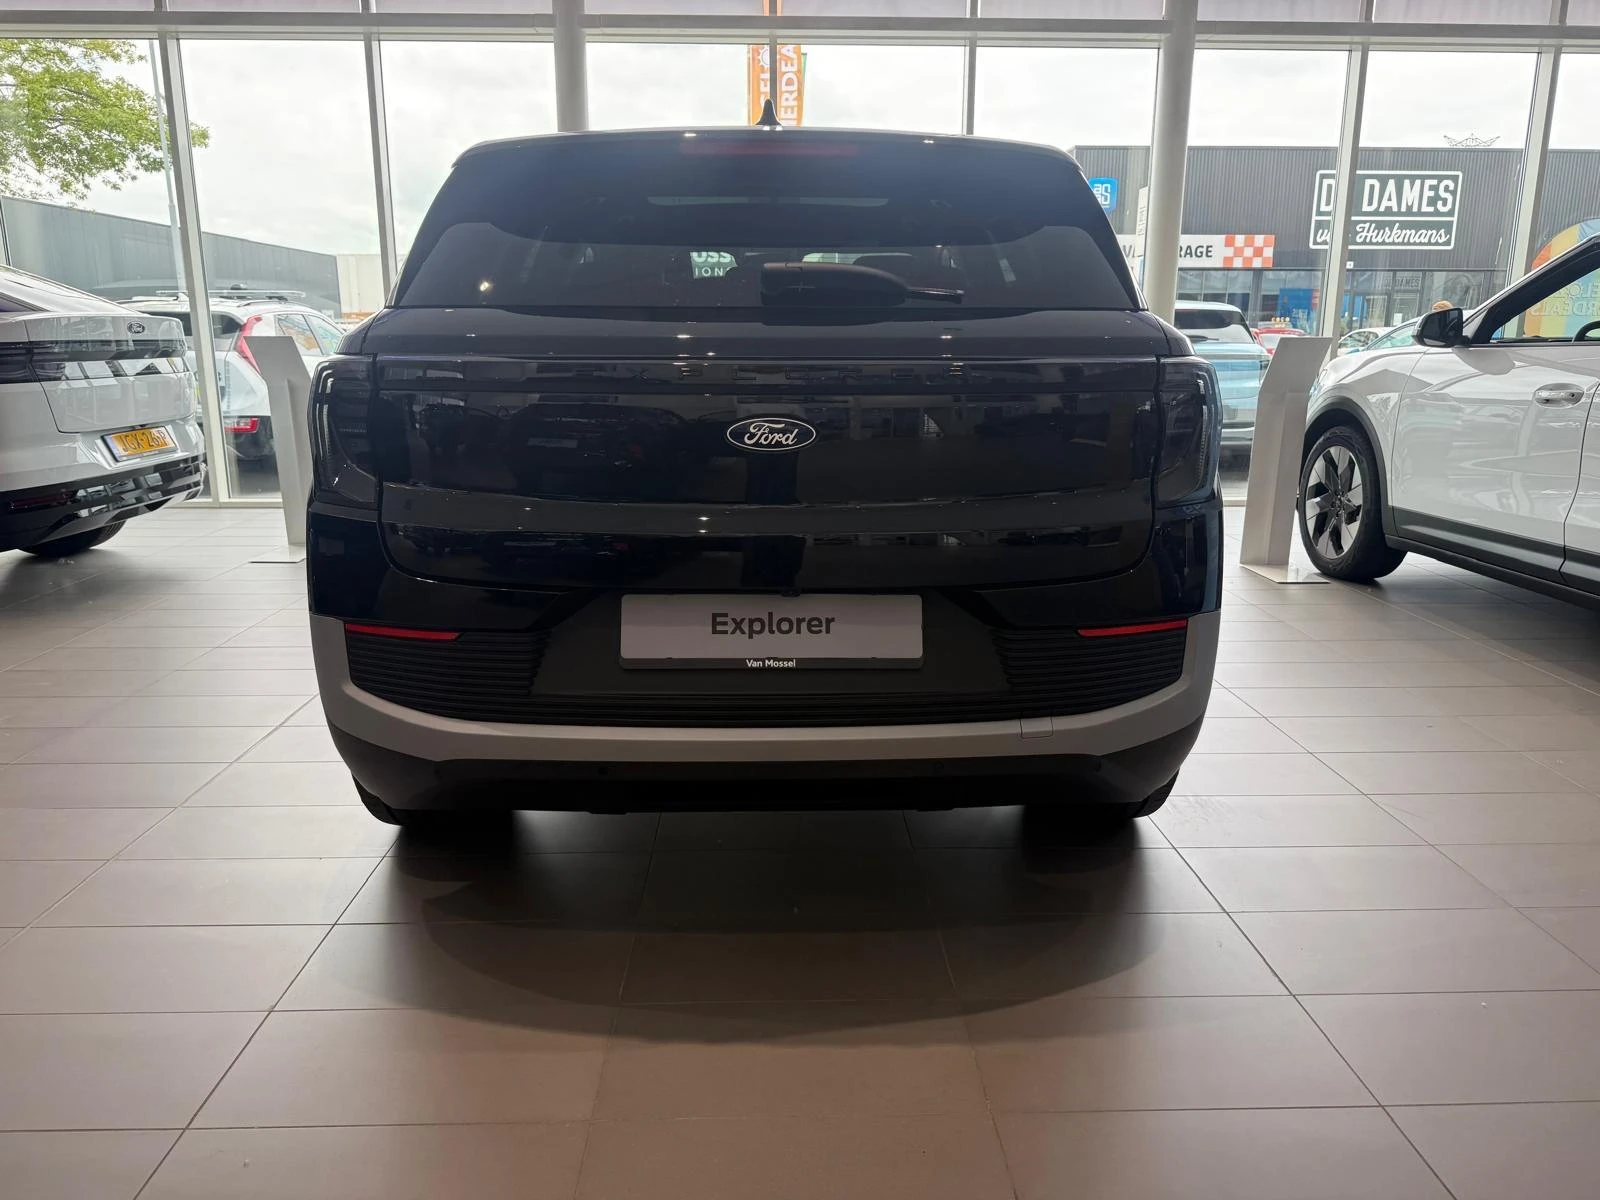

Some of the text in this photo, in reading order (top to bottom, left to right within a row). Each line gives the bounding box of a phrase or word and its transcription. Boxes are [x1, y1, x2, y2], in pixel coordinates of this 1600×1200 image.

[1361, 178, 1455, 213] DAMES
[1356, 222, 1450, 244] Hurkmans
[743, 422, 799, 445] Ford
[711, 611, 836, 640] Explorer
[745, 659, 796, 668] Van Mossel
